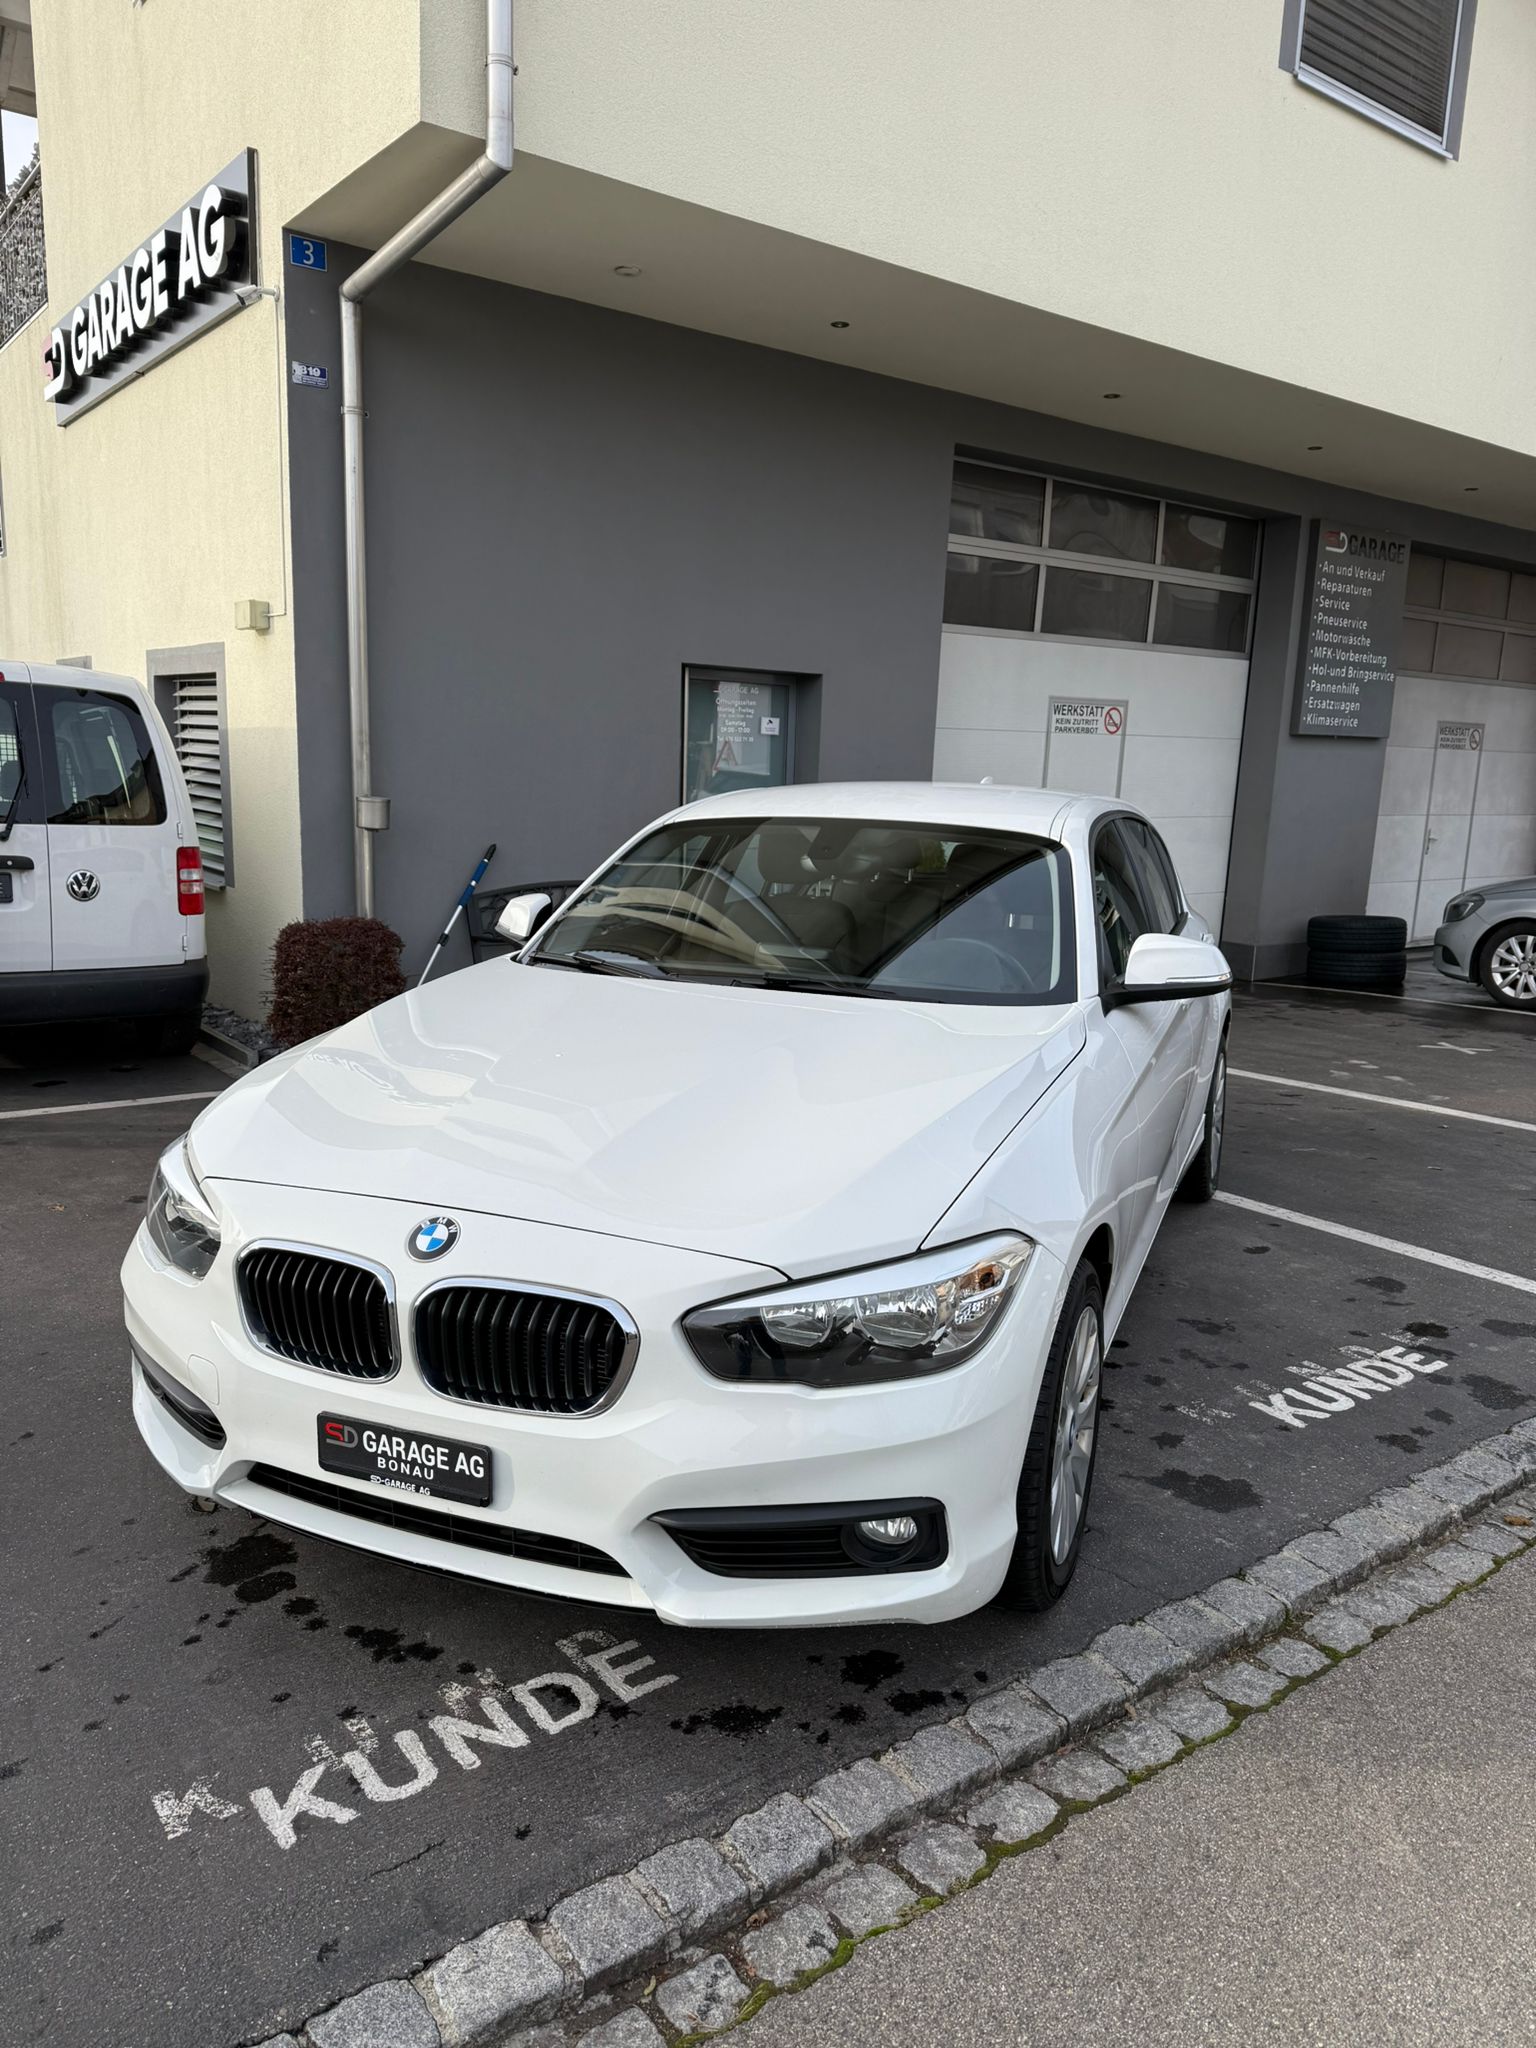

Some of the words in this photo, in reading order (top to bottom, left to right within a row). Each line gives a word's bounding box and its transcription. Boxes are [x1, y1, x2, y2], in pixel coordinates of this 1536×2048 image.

[303, 241, 314, 264] 3
[71, 229, 168, 376] GARAGE
[178, 184, 226, 300] AG
[1349, 535, 1406, 564] GARAGE
[1337, 565, 1352, 576] und
[1355, 566, 1385, 582] Verkauf
[1347, 666, 1395, 682] Bringservice
[1053, 704, 1105, 717] WERKSTATT
[1054, 726, 1099, 734] PARKVERBOT
[1072, 718, 1100, 726] ZUTRITT
[324, 1421, 358, 1448] SD
[362, 1430, 449, 1471] GARAGE
[455, 1452, 485, 1478] AG
[377, 1456, 434, 1480] BONAU
[370, 1474, 416, 1493] SD-GARAGE
[419, 1486, 431, 1496] AG
